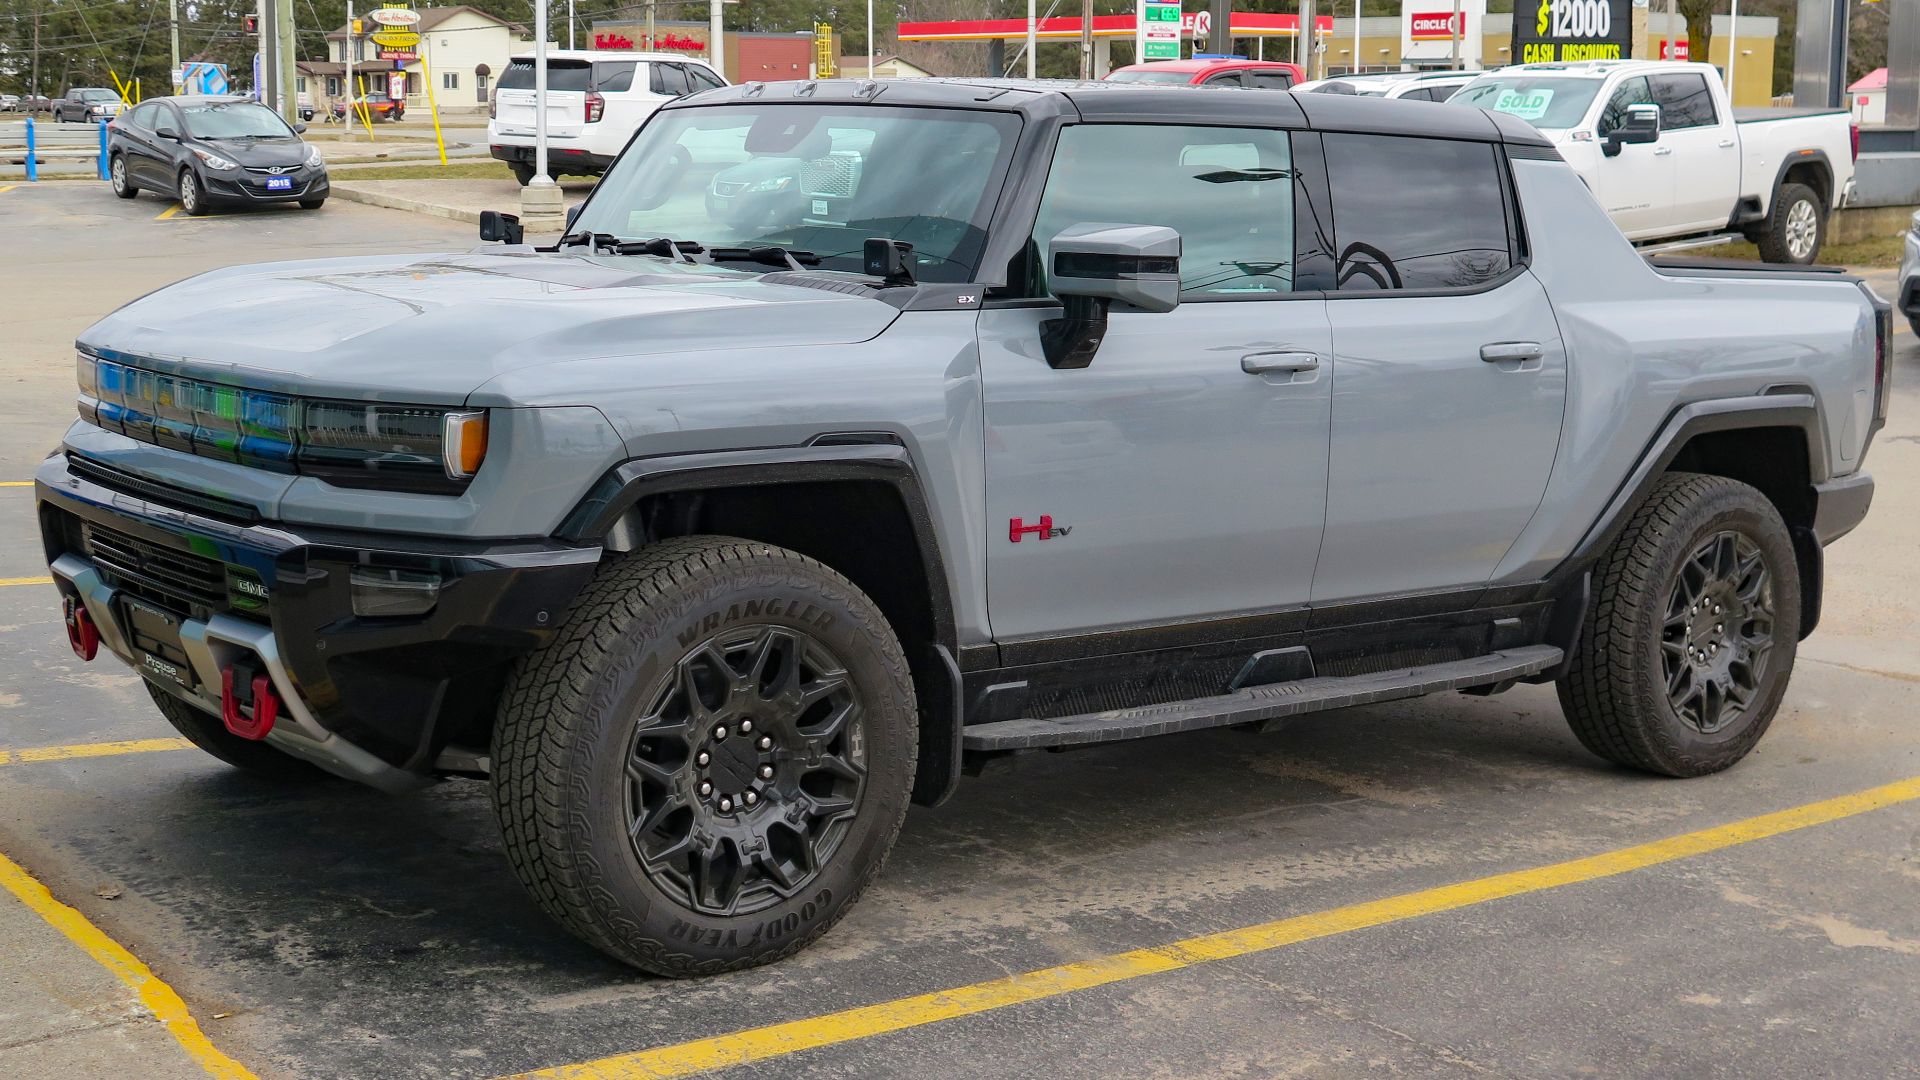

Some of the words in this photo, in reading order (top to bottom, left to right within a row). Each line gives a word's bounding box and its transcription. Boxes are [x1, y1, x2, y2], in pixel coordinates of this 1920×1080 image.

[1414, 19, 1446, 30] CIRCLE
[1537, 0, 1610, 37] $12000
[664, 34, 704, 50] Hortons
[1524, 44, 1555, 63] CASH
[1562, 44, 1620, 62] DISCOUNTS
[1500, 96, 1544, 108] SOLD
[268, 179, 290, 188] 2015
[238, 580, 269, 598] GMC
[677, 598, 836, 648] WRANGLER
[145, 653, 176, 676] Prouse
